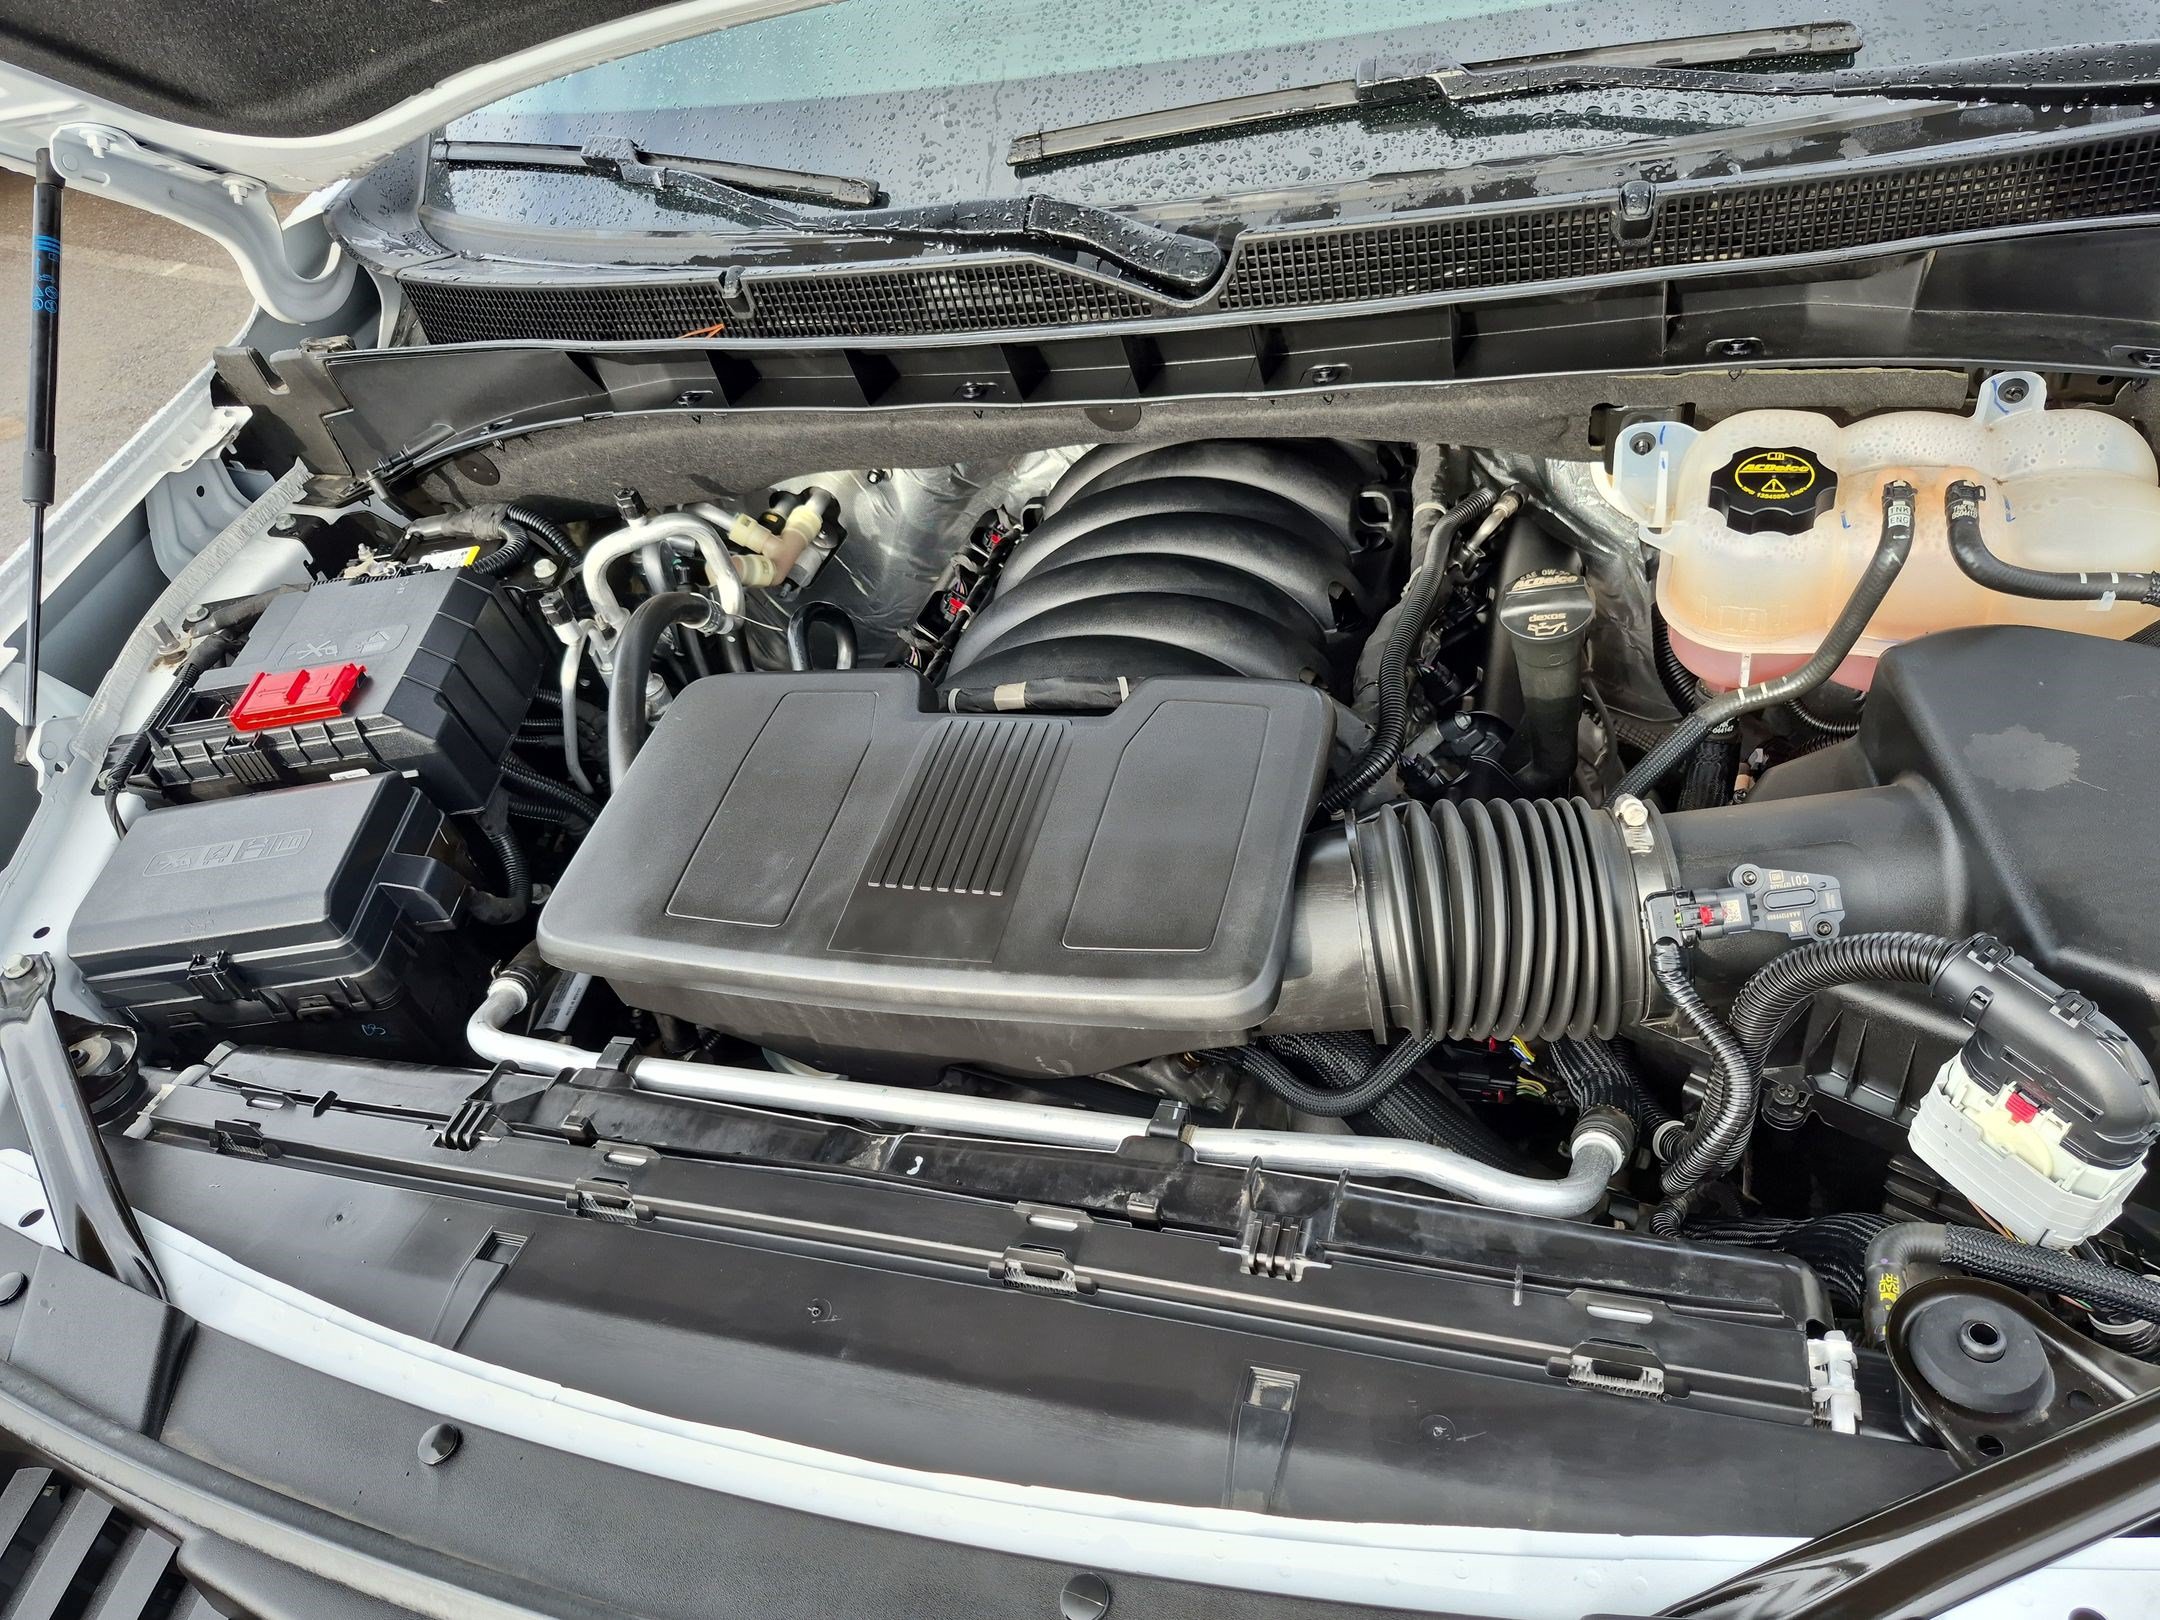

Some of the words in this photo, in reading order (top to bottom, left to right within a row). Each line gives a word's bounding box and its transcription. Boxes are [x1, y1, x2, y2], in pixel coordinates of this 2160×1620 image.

[1741, 464, 1810, 473] ACDelco
[1889, 506, 1909, 514] TNK
[1890, 516, 1909, 524] ENG
[1520, 571, 1538, 581] SAE
[1512, 576, 1578, 591] ACDelco
[1528, 613, 1567, 622] dexos
[1878, 1282, 1900, 1294] RAD
